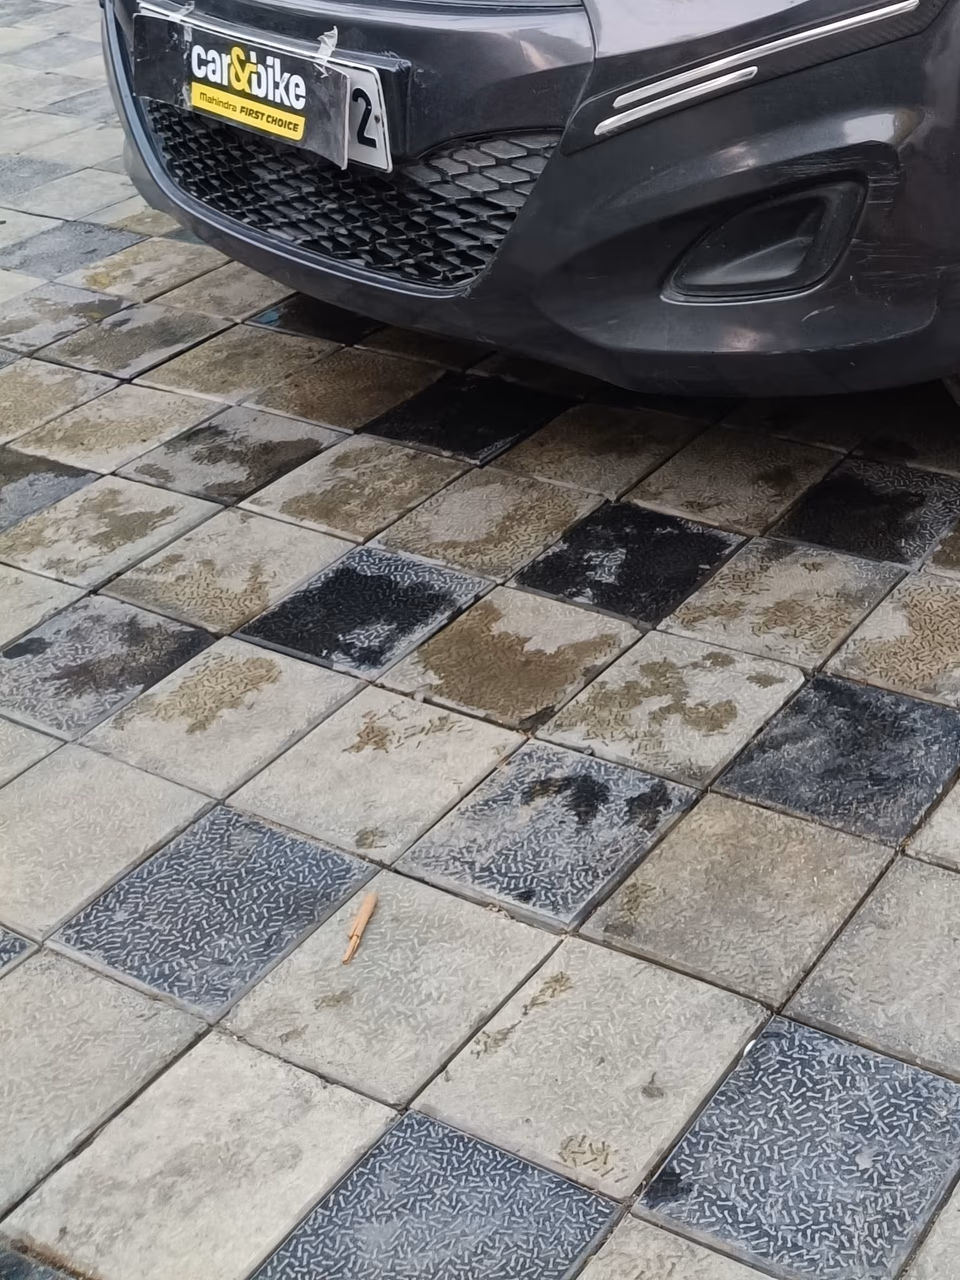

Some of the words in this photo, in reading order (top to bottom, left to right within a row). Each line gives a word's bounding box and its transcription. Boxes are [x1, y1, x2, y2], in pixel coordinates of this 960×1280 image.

[191, 44, 306, 110] car&bike
[199, 92, 238, 113] Mahindra
[240, 105, 265, 121] FIRST
[266, 115, 299, 132] CHOICE
[352, 88, 377, 149] 2
